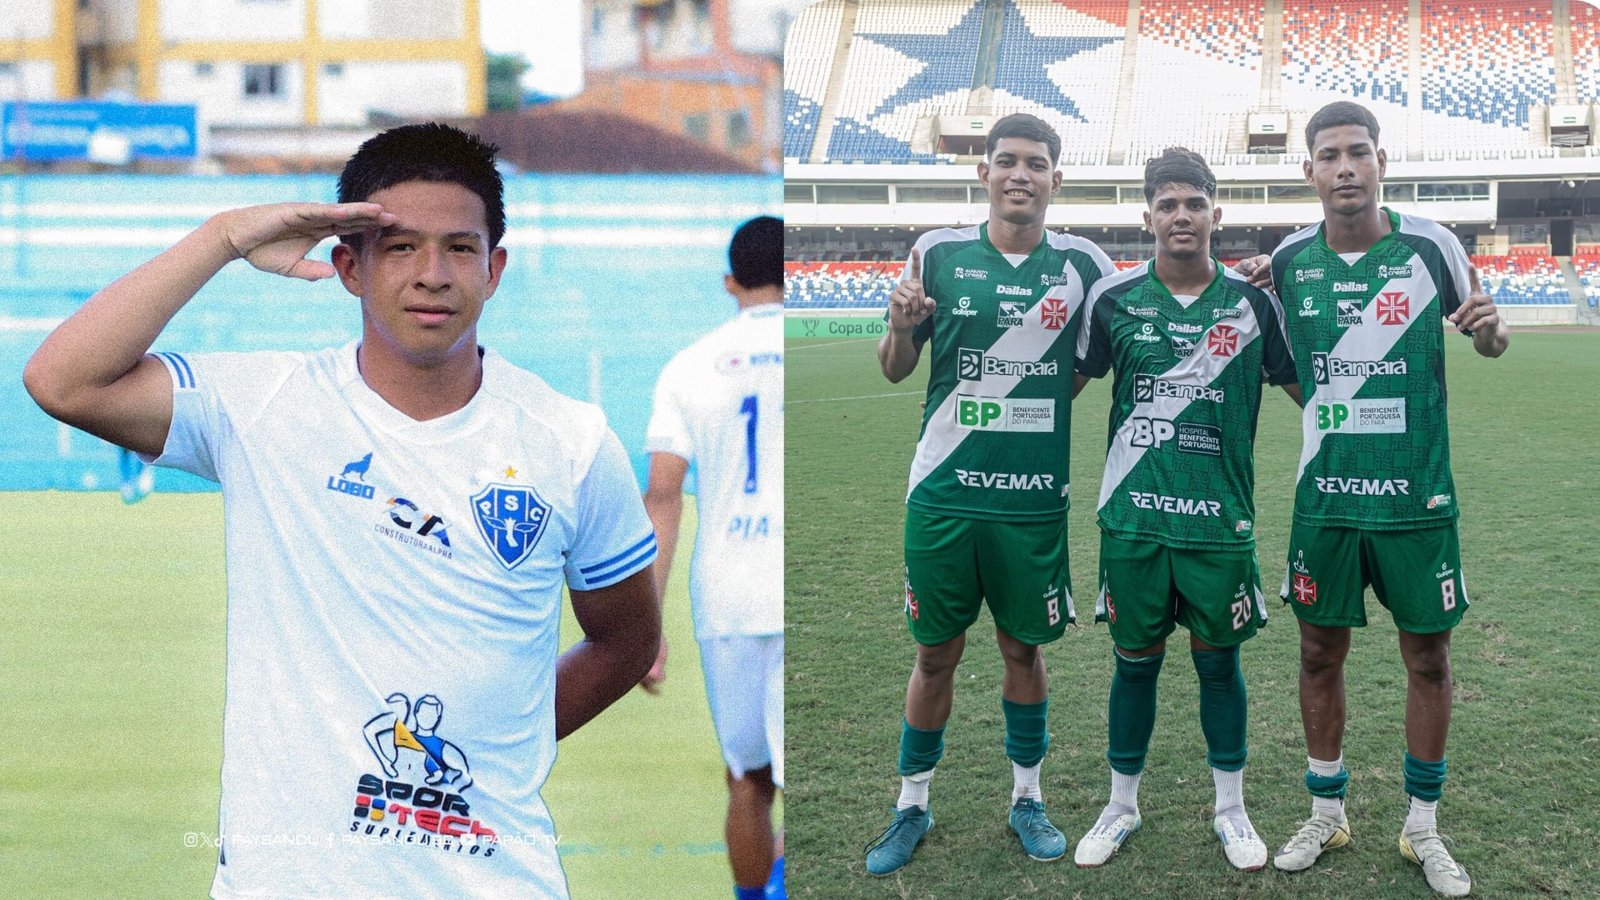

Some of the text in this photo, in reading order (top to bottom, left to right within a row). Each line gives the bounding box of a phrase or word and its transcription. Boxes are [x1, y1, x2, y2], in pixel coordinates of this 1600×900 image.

[996, 285, 1032, 296] Dallas
[1333, 282, 1368, 292] Dallas
[829, 321, 883, 336] Copa do
[1168, 322, 1203, 333] Dallas
[983, 357, 1058, 378] Banpará
[1329, 358, 1407, 379] Banpará
[1154, 379, 1224, 403] Banpará
[960, 400, 1001, 427] BP
[1317, 404, 1349, 430] BP
[1131, 417, 1175, 449] BP
[1179, 427, 1209, 437] HOSPITAL
[1179, 434, 1220, 445] BENEFICENTE
[1178, 440, 1221, 451] PORTUGUESA
[326, 476, 376, 500] LOBO
[955, 469, 1054, 490] REVEMAR
[1315, 477, 1410, 496] REVEMAR
[1128, 491, 1222, 517] REVEMAR
[1441, 578, 1456, 611] 8
[1047, 596, 1061, 627] 9
[1231, 595, 1252, 631] 20
